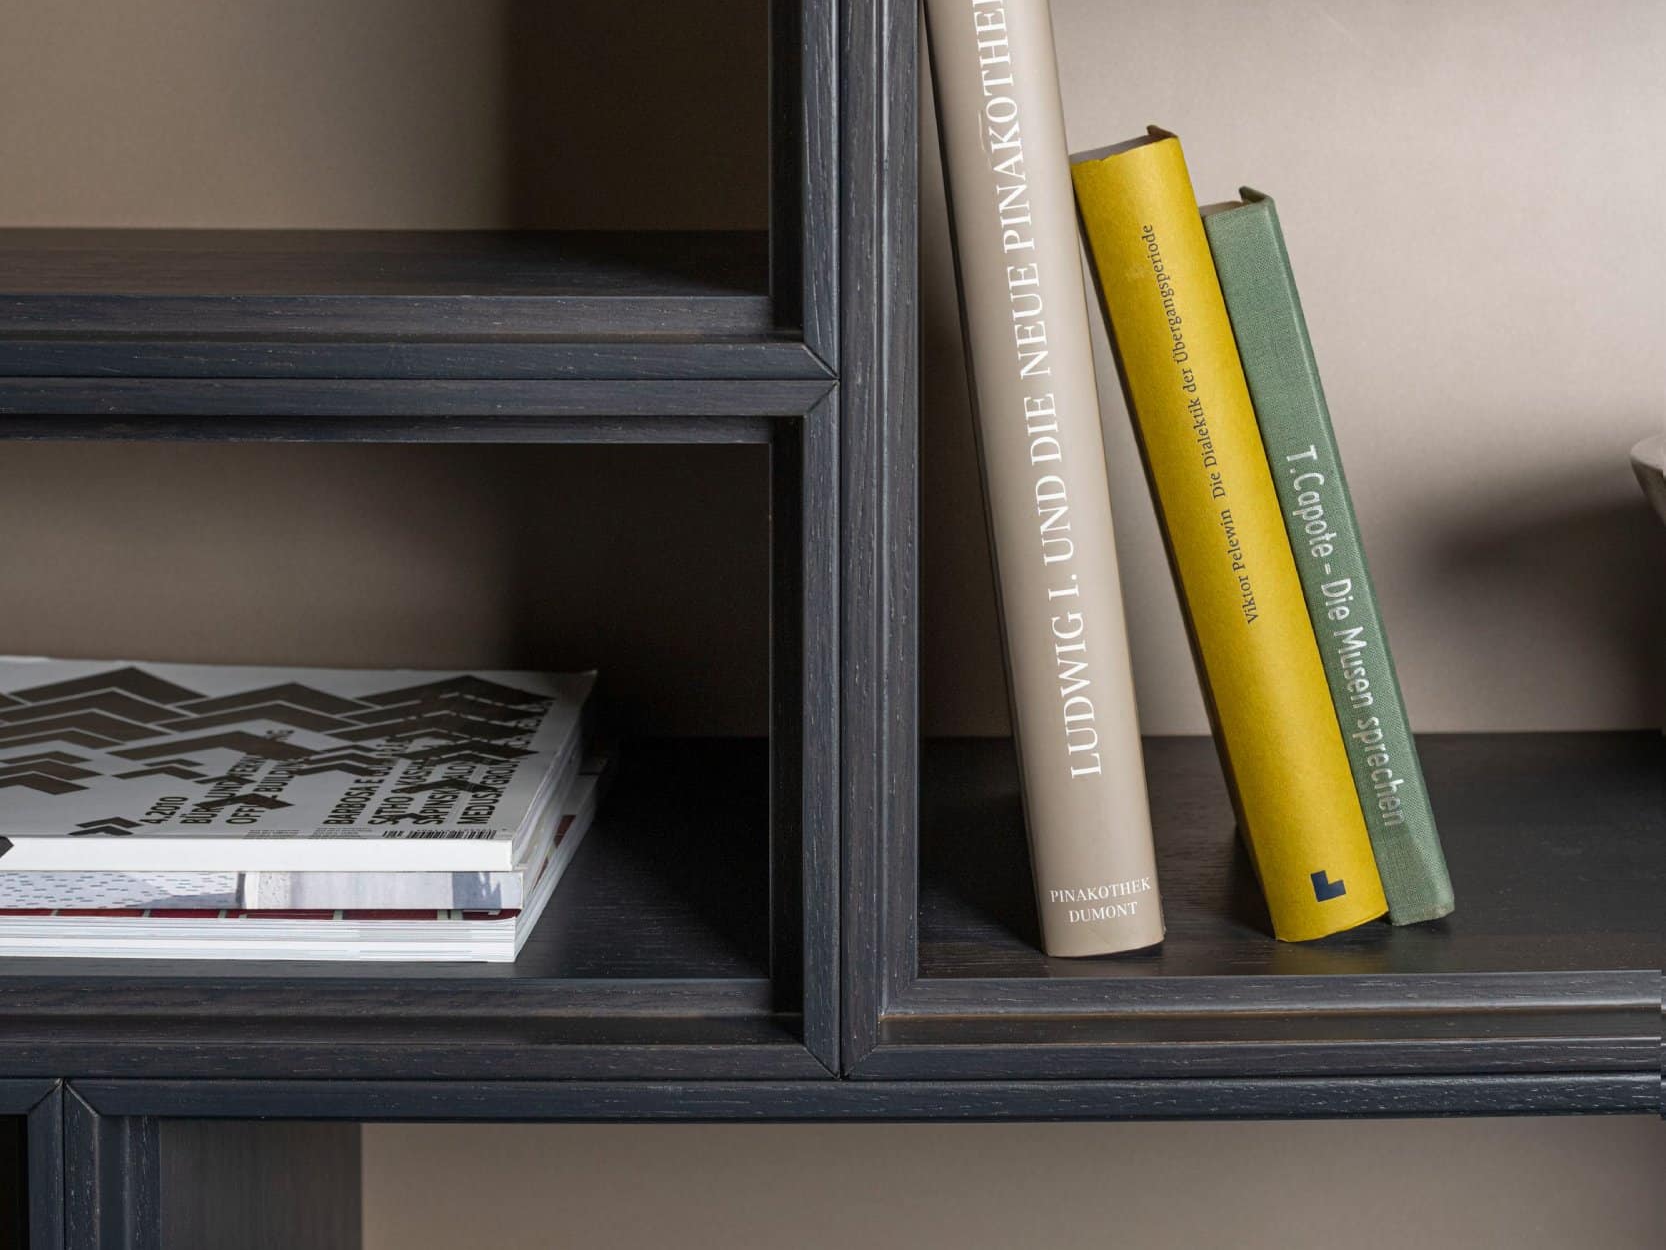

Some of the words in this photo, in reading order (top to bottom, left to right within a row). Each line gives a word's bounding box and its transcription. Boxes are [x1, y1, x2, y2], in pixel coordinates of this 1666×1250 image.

[1007, 262, 1051, 380] NEUE
[1141, 225, 1189, 364] Übergangsperiode
[1182, 369, 1197, 393] der
[1023, 393, 1062, 466] DIE
[1188, 398, 1217, 468] Dialektik
[1210, 472, 1226, 500] Die
[1035, 475, 1077, 566] UND
[1220, 509, 1246, 572] Pelewin
[1048, 573, 1080, 601] I.
[1239, 575, 1259, 624] Viktor
[1320, 578, 1354, 621] Die
[1051, 611, 1102, 779] LUDWIG
[1333, 625, 1375, 710] Musen
[1352, 715, 1408, 829] sprechen
[139, 796, 189, 824] 4.2010
[321, 785, 380, 824] BARBOSA
[1050, 877, 1151, 903] PINAKOTHEK
[1068, 901, 1138, 923] DUMONT
